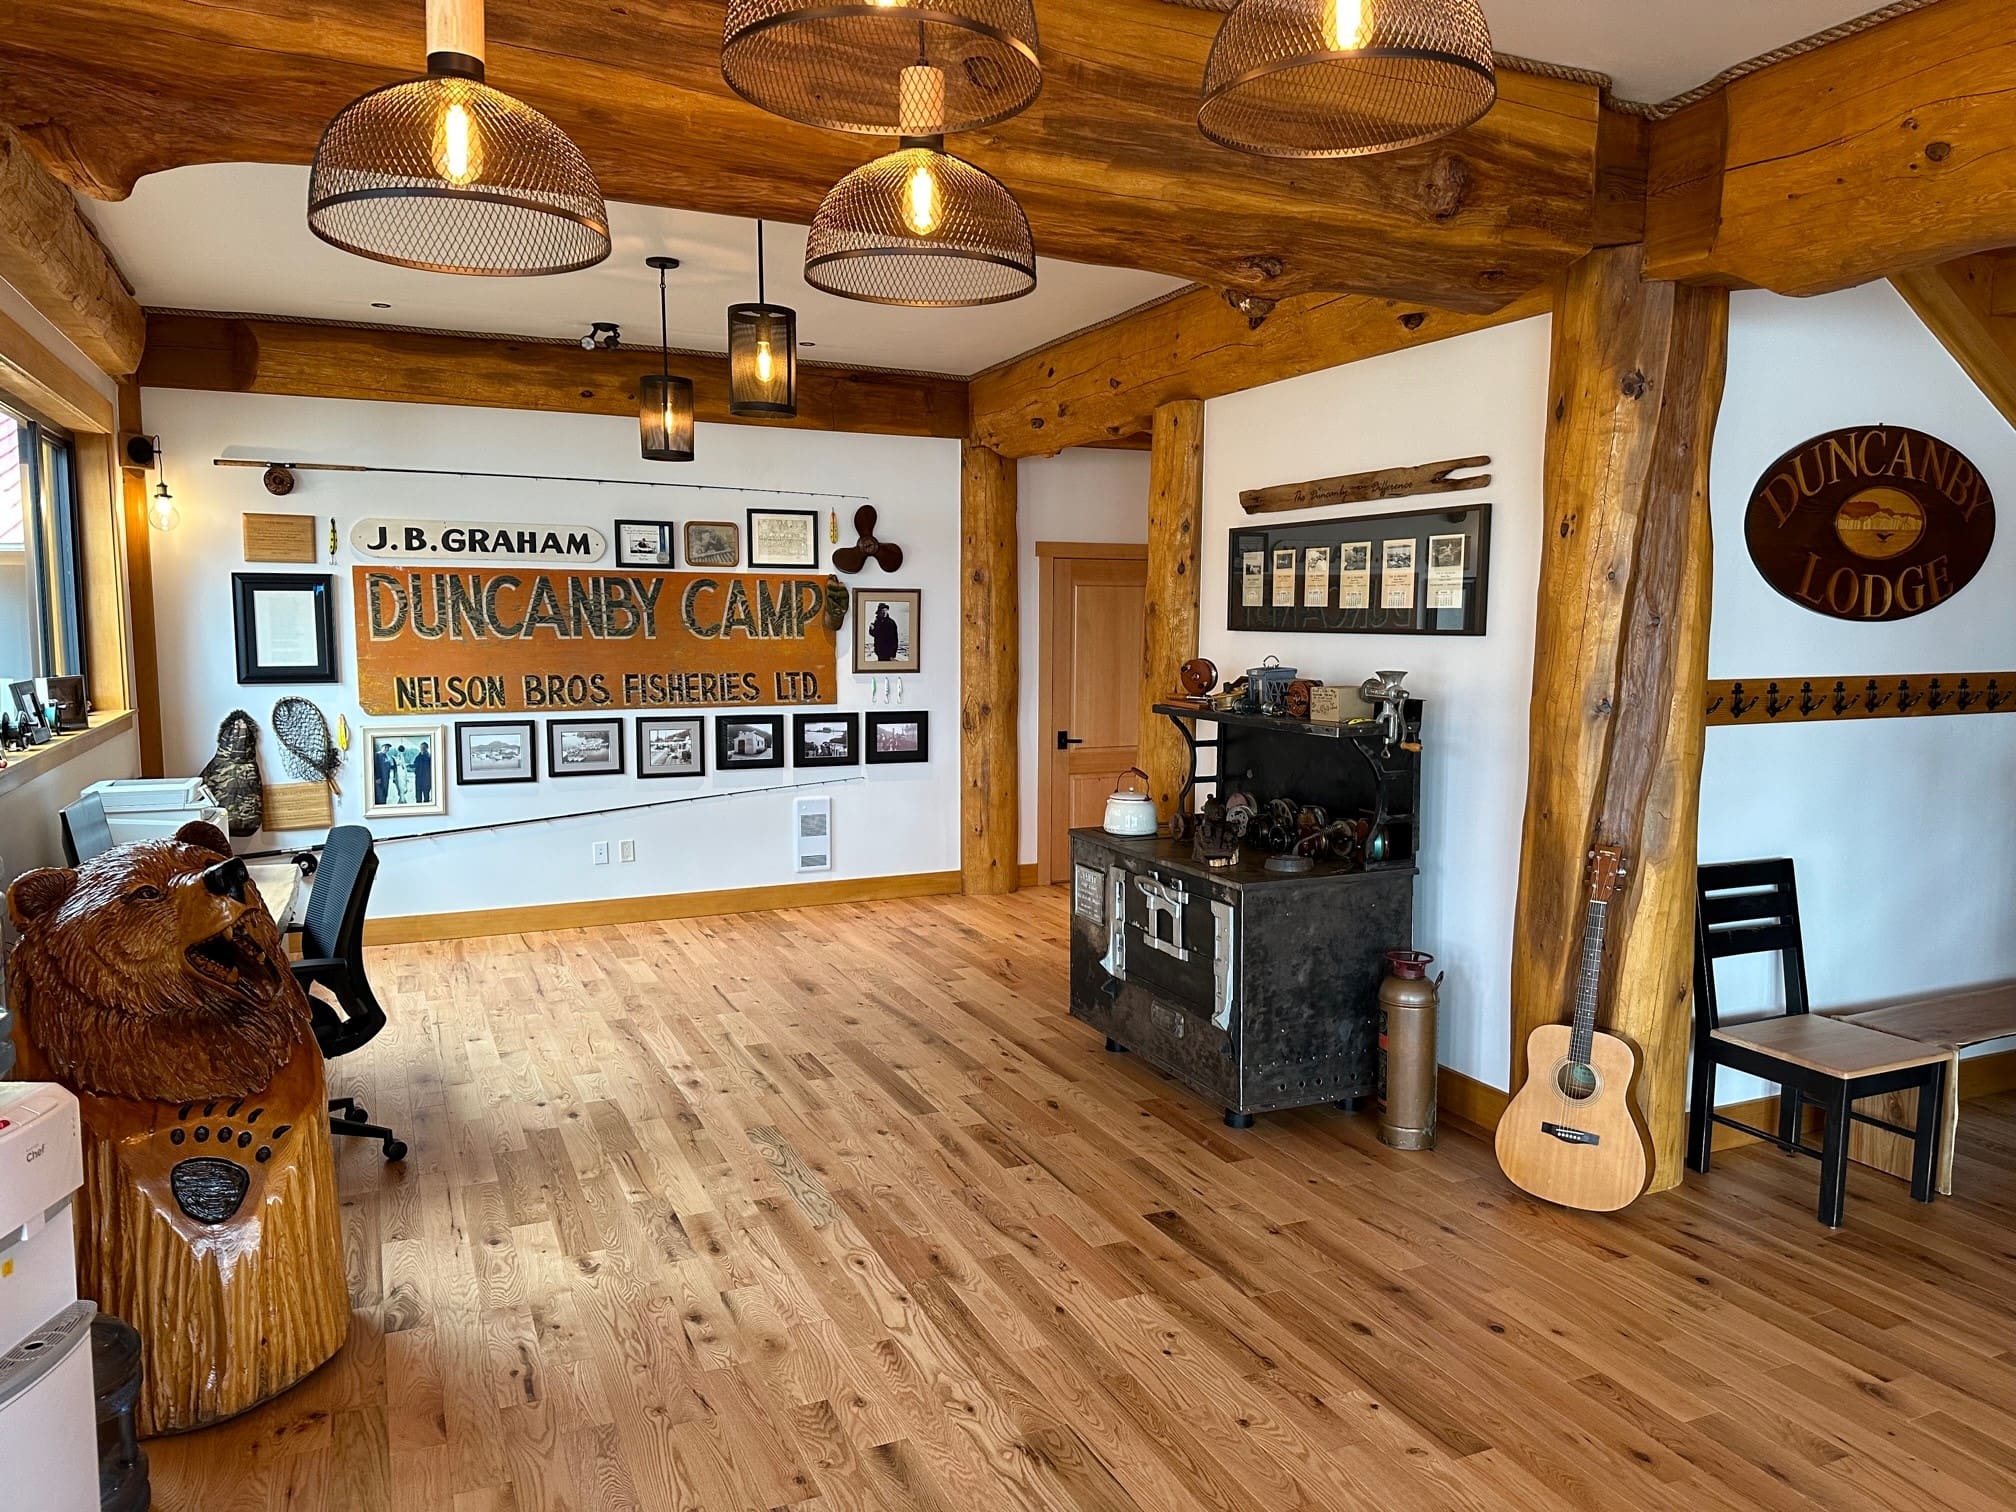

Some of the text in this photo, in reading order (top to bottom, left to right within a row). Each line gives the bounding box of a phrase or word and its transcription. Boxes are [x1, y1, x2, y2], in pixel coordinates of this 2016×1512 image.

[1760, 430, 1993, 529] DUNCANBY
[365, 573, 664, 642] DUNCANBY
[681, 578, 824, 641] CAMP
[1794, 552, 1953, 618] LODGE
[393, 671, 822, 711] NELSON BROS. FISHERIES LTD.
[26, 1143, 46, 1163] Chef
